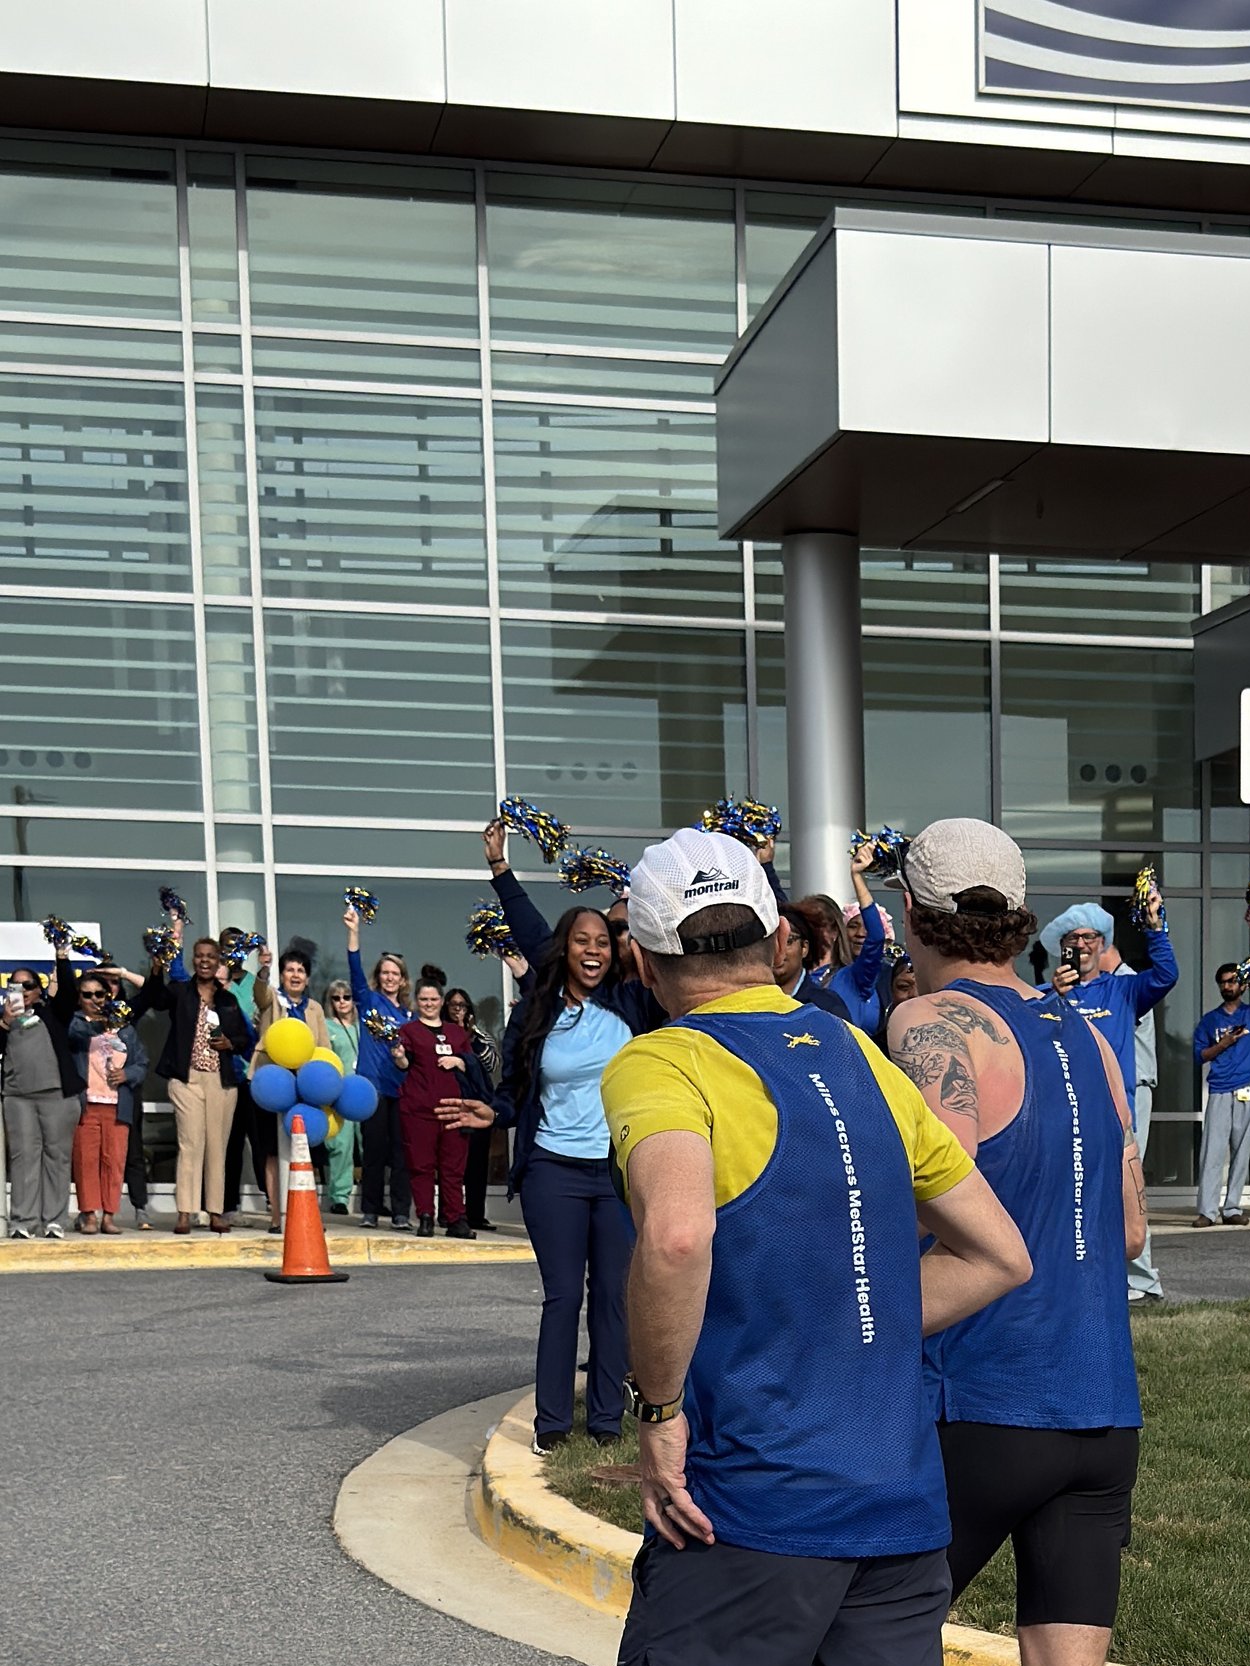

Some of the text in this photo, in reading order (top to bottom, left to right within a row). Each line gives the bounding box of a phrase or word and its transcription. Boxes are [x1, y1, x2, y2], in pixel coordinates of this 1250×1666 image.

[684, 880, 739, 899] montrail
[808, 1073, 876, 1344] Miles across MedStar Health
[1052, 1040, 1087, 1261] Miles across MedStar Health
